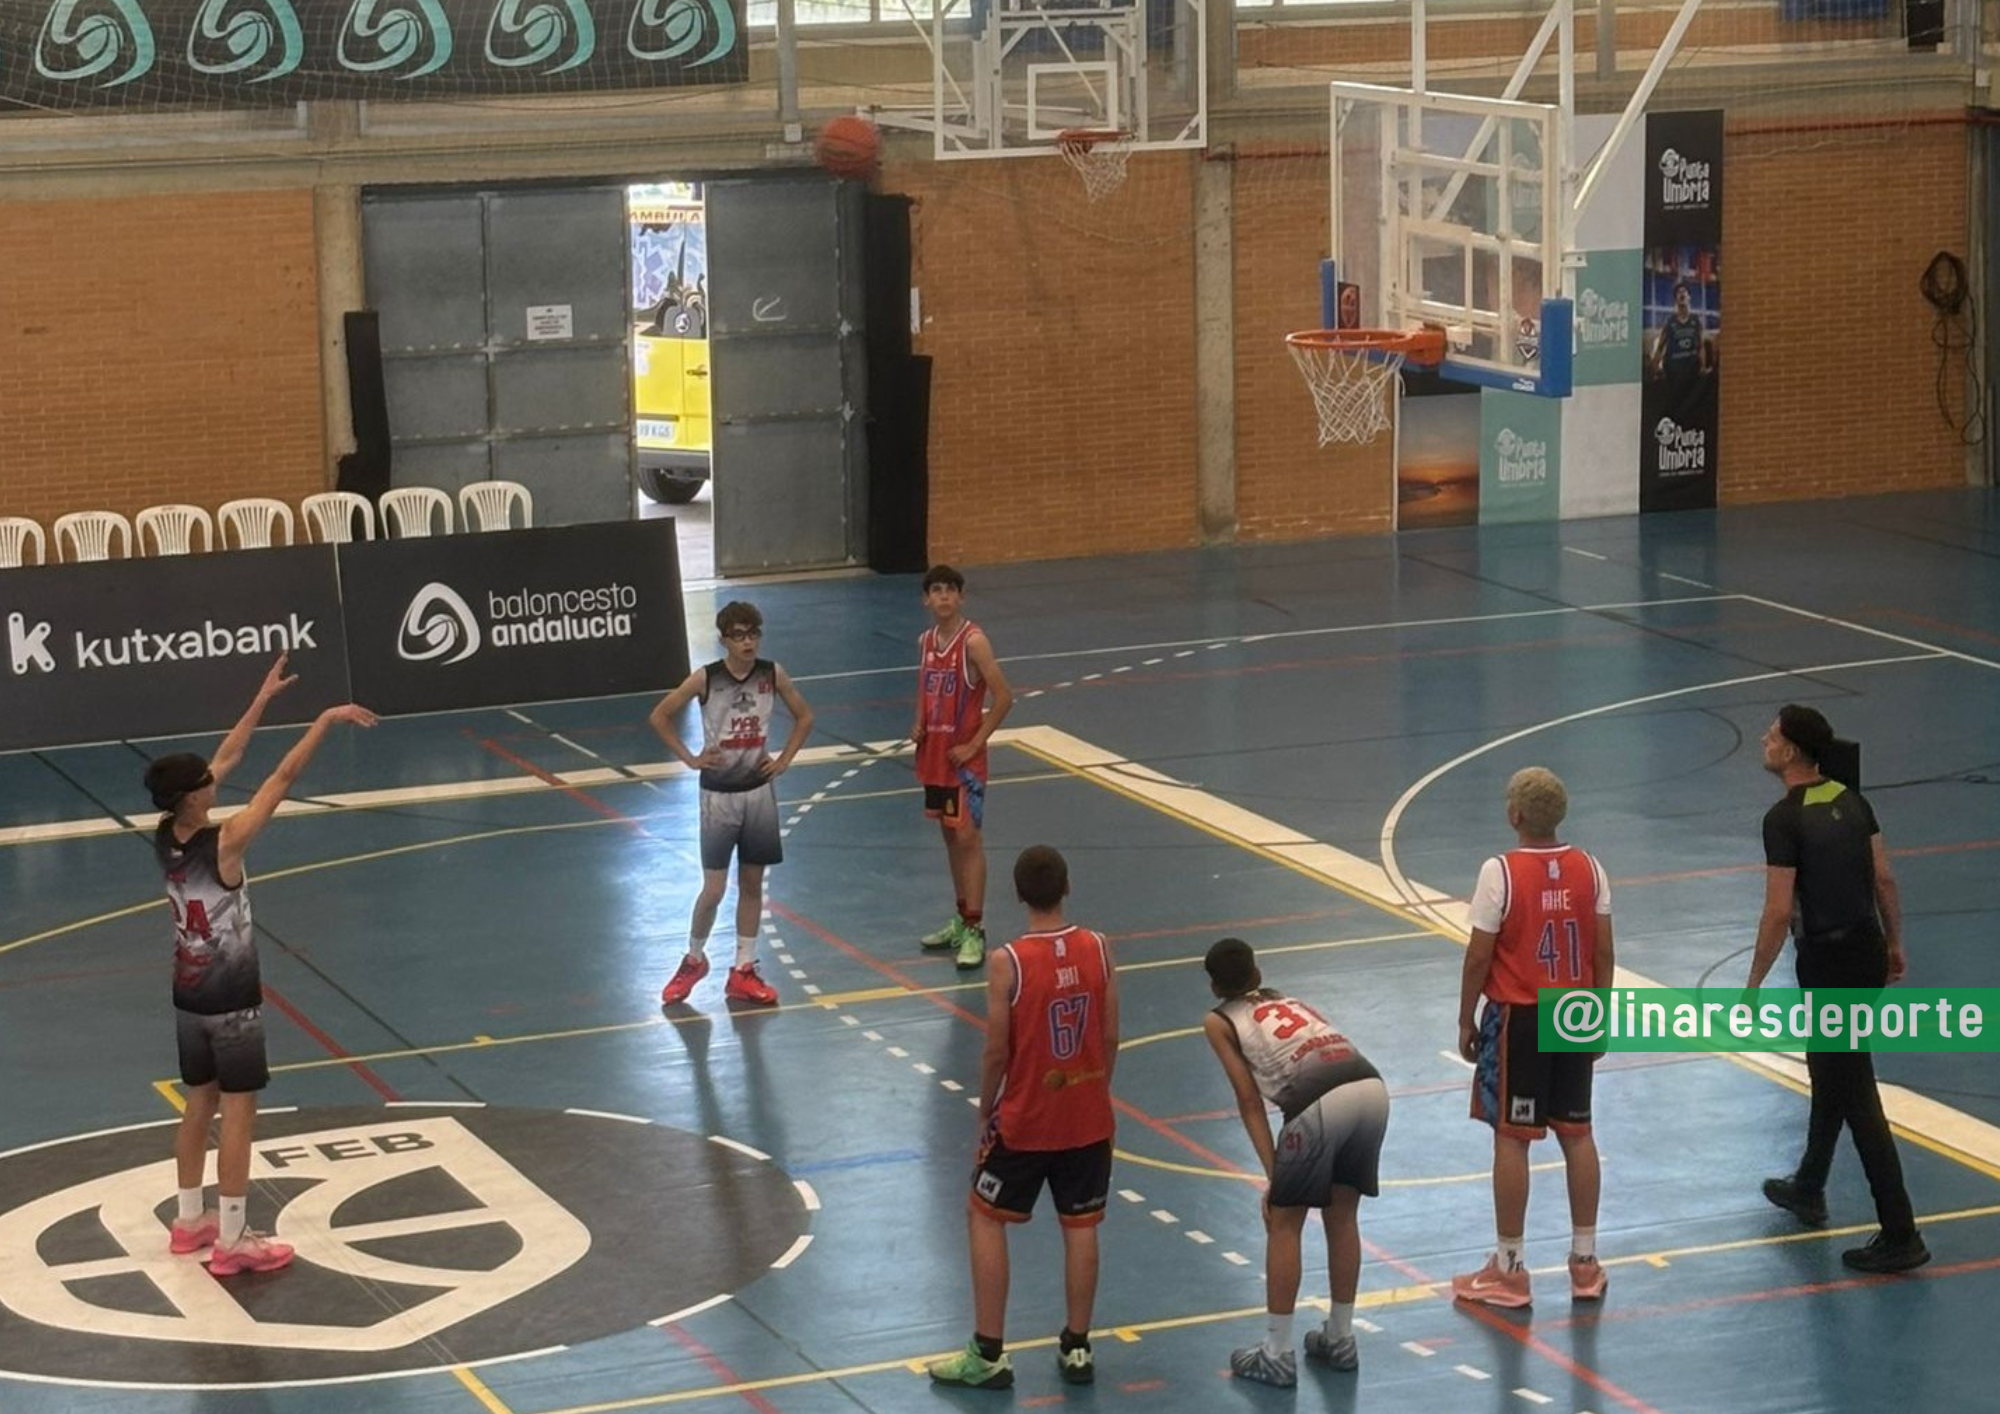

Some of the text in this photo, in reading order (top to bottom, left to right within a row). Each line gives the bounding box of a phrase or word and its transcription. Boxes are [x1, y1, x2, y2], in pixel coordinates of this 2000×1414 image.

[1679, 157, 1709, 180] Punta
[1675, 425, 1705, 449] Punta
[489, 582, 637, 619] baloncesto
[76, 613, 317, 669] kutxabank
[1536, 918, 1581, 983] 41
[1049, 992, 1090, 1060] 67
[259, 1132, 435, 1169] FEB
